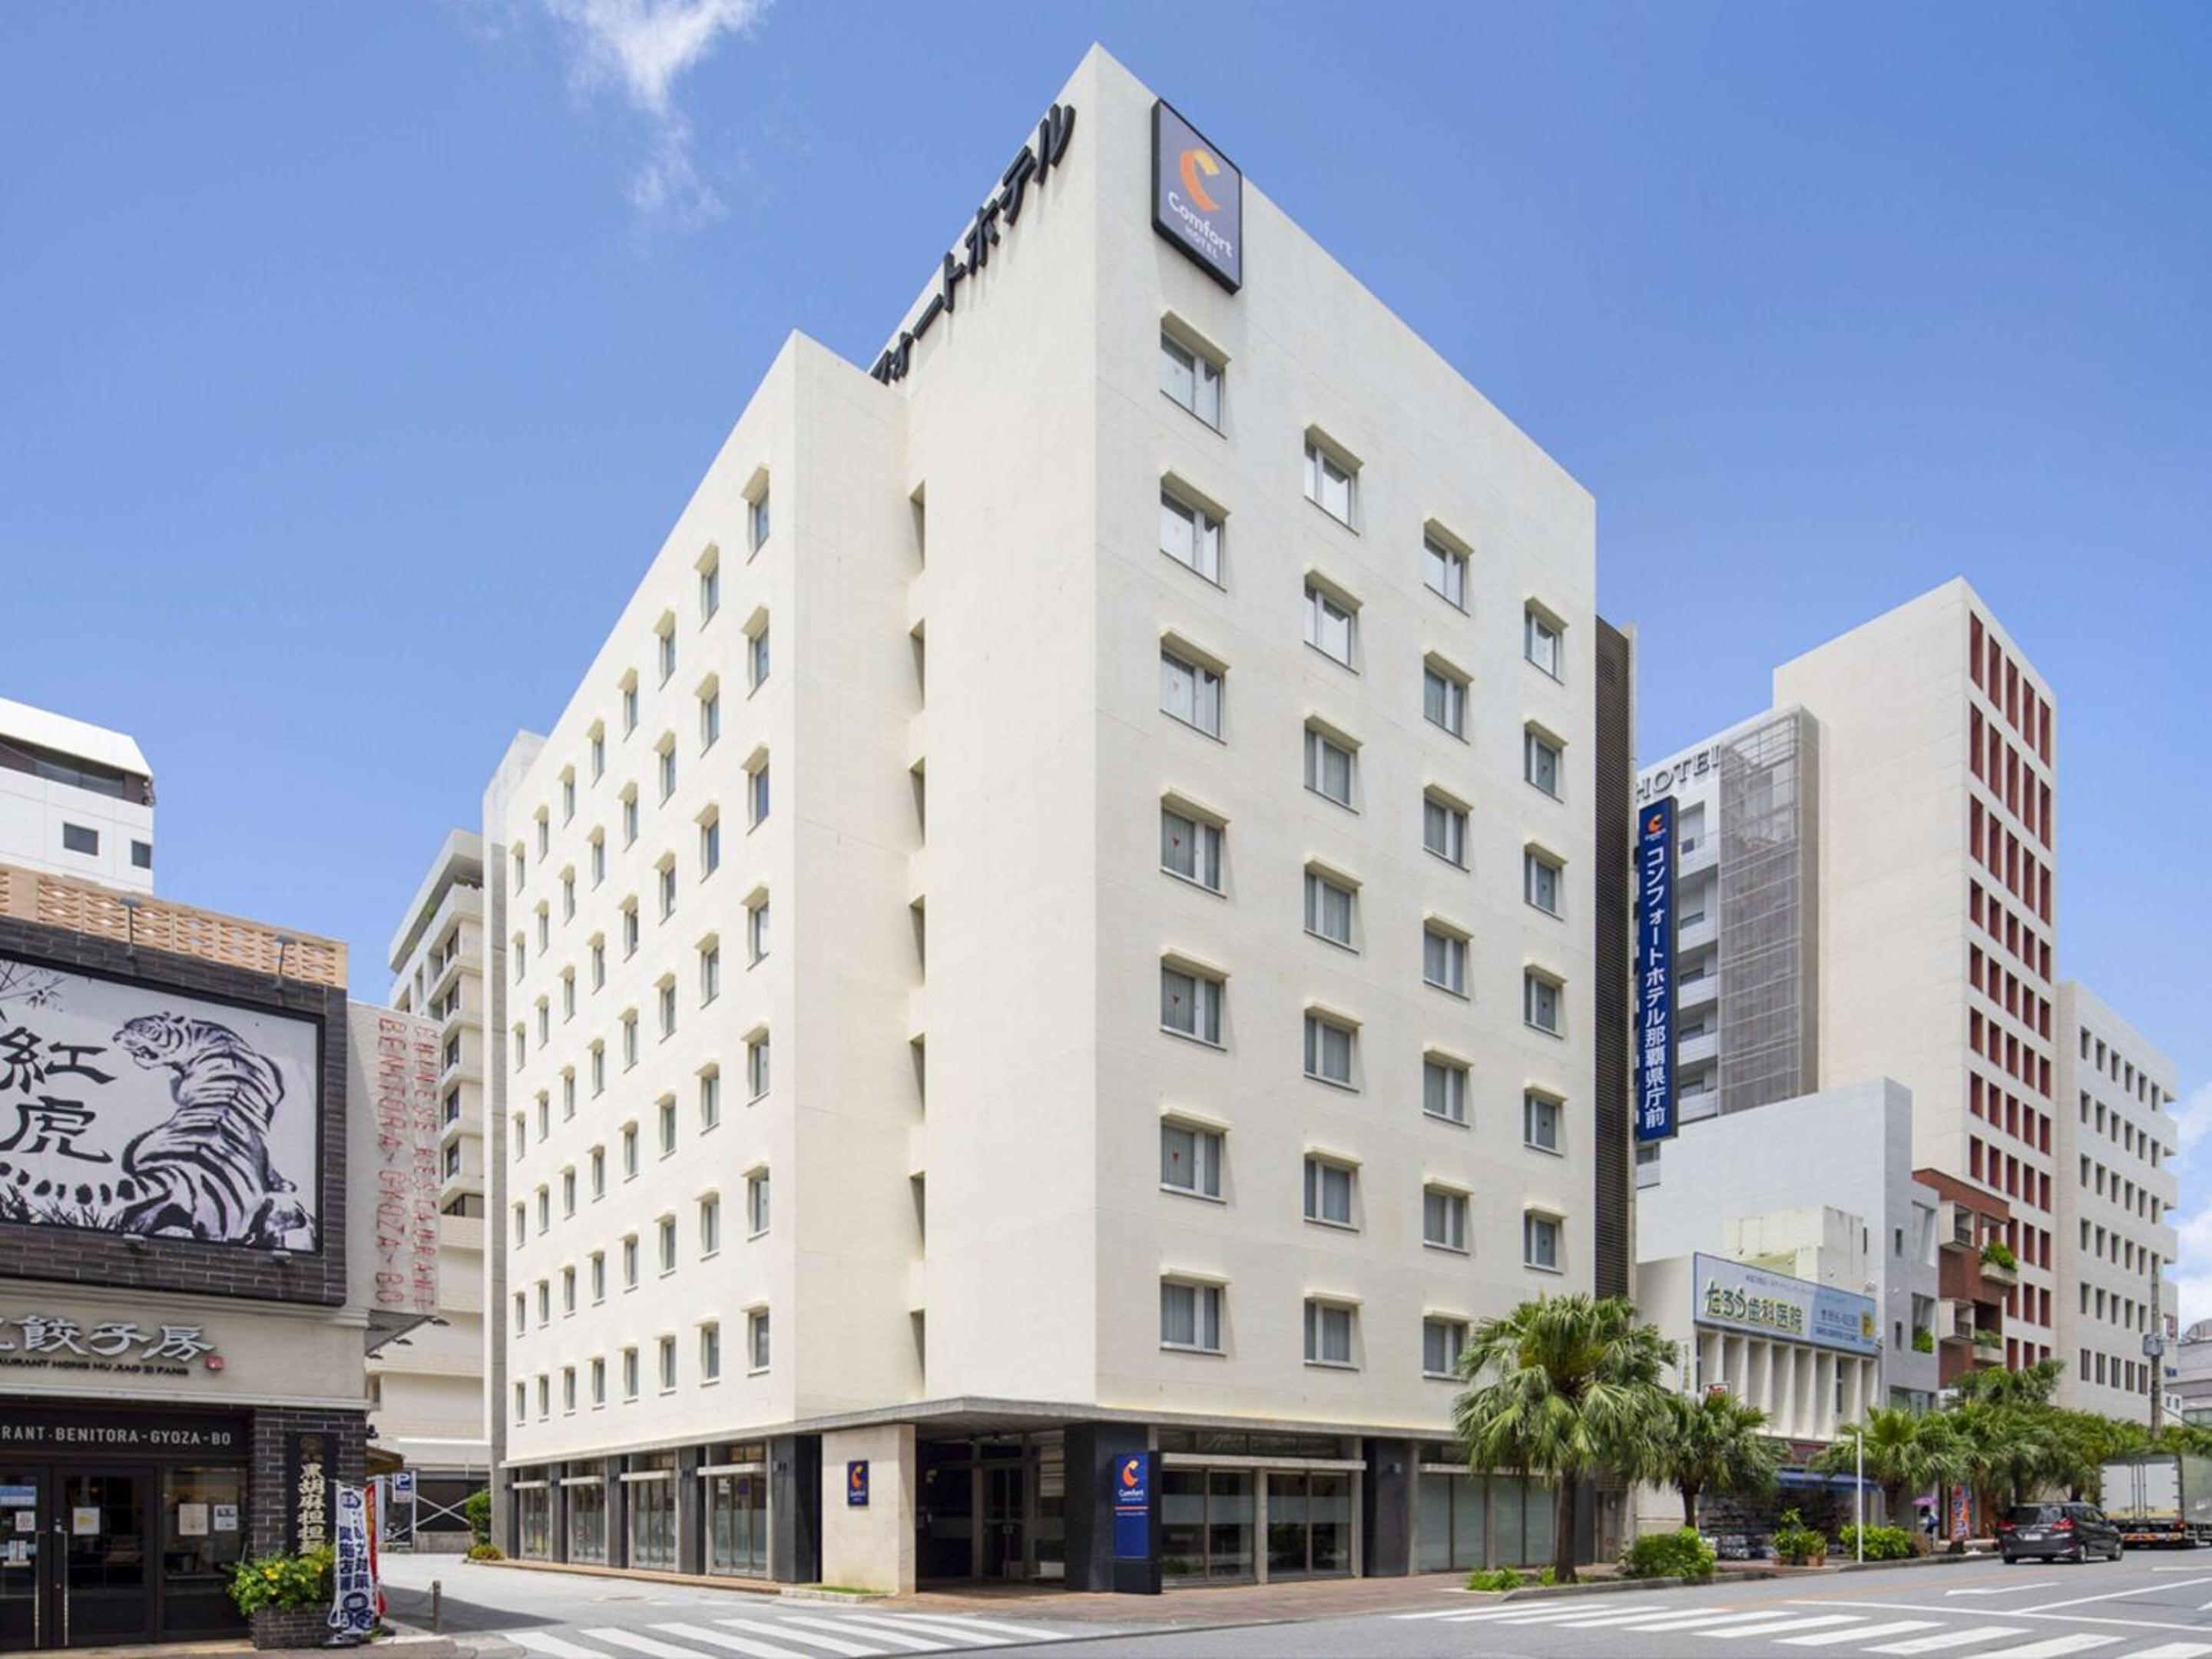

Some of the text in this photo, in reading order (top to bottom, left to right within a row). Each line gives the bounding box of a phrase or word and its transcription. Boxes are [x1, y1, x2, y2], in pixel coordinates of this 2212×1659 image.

[1168, 191, 1233, 258] Comfort
[1645, 846, 1667, 1130] コンフォートホテル那覇県庁前
[0, 1315, 215, 1362] 餃子房
[396, 1473, 410, 1486] P
